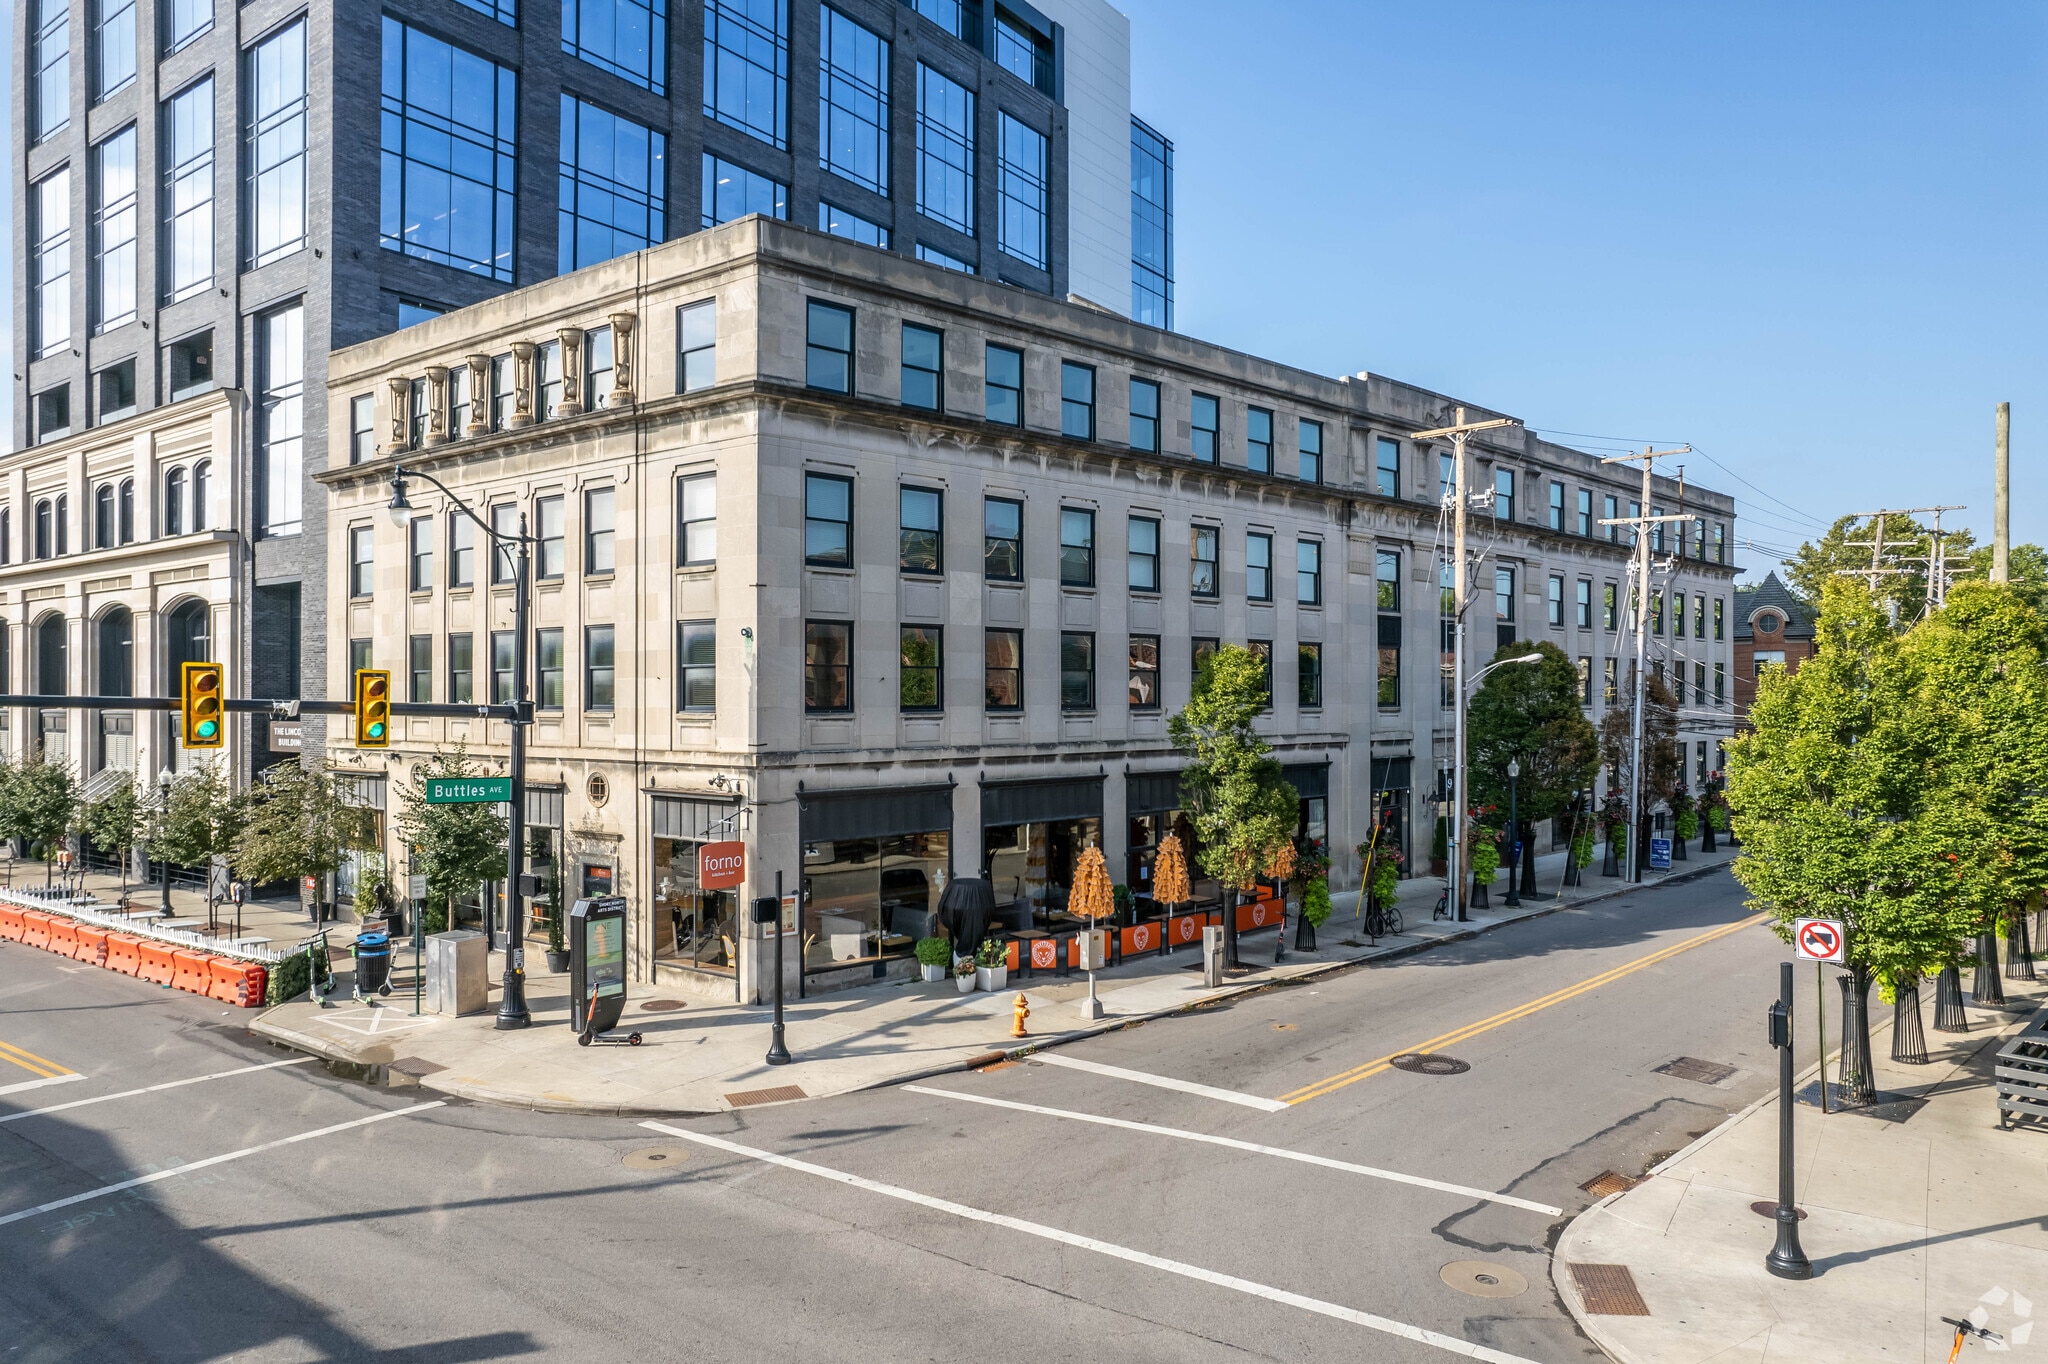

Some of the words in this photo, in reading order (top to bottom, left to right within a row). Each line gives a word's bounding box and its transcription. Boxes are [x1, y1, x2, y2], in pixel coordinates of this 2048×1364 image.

[274, 727, 285, 735] THE
[434, 785, 485, 798] Buttles
[704, 855, 742, 871] forno
